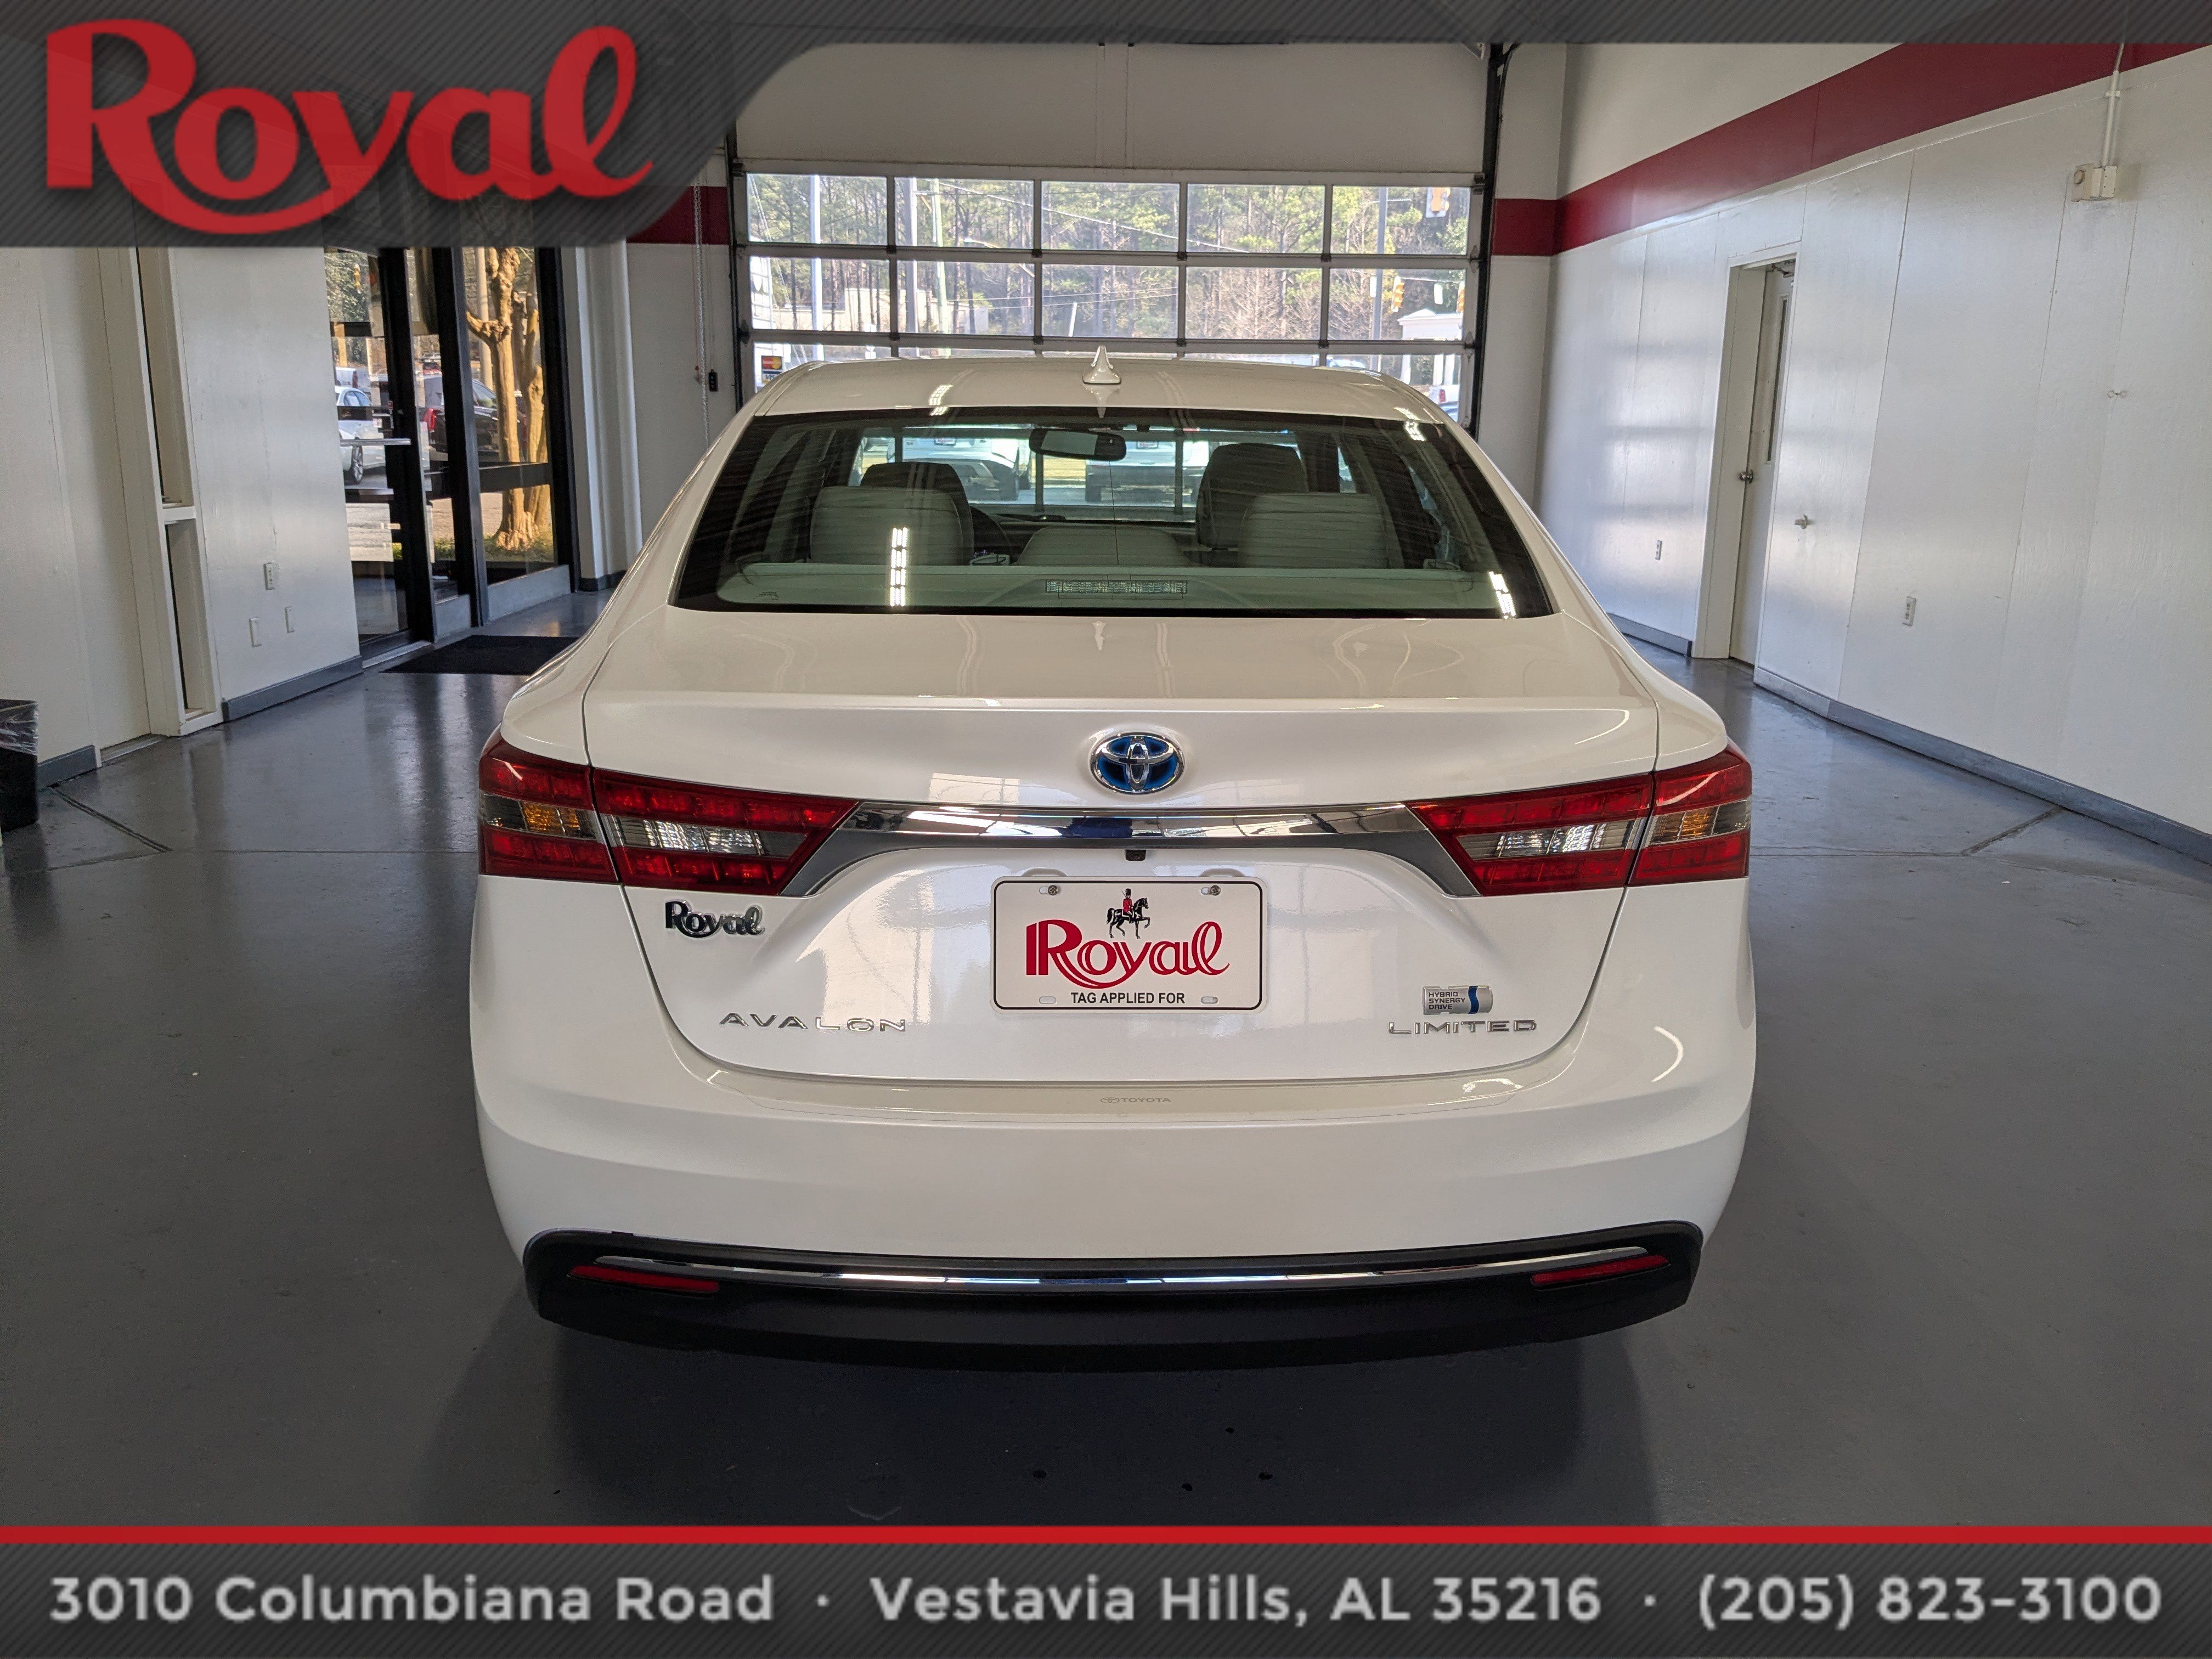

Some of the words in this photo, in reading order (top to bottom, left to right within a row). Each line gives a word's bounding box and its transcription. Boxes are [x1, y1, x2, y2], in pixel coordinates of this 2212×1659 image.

[665, 900, 765, 938] Royal
[1025, 919, 1230, 989] Royal
[1071, 992, 1097, 1004] TAG
[1099, 992, 1154, 1004] APPLIED
[1159, 992, 1186, 1004] FOR
[720, 1013, 906, 1032] AVALON
[1388, 1020, 1537, 1034] LIMITED
